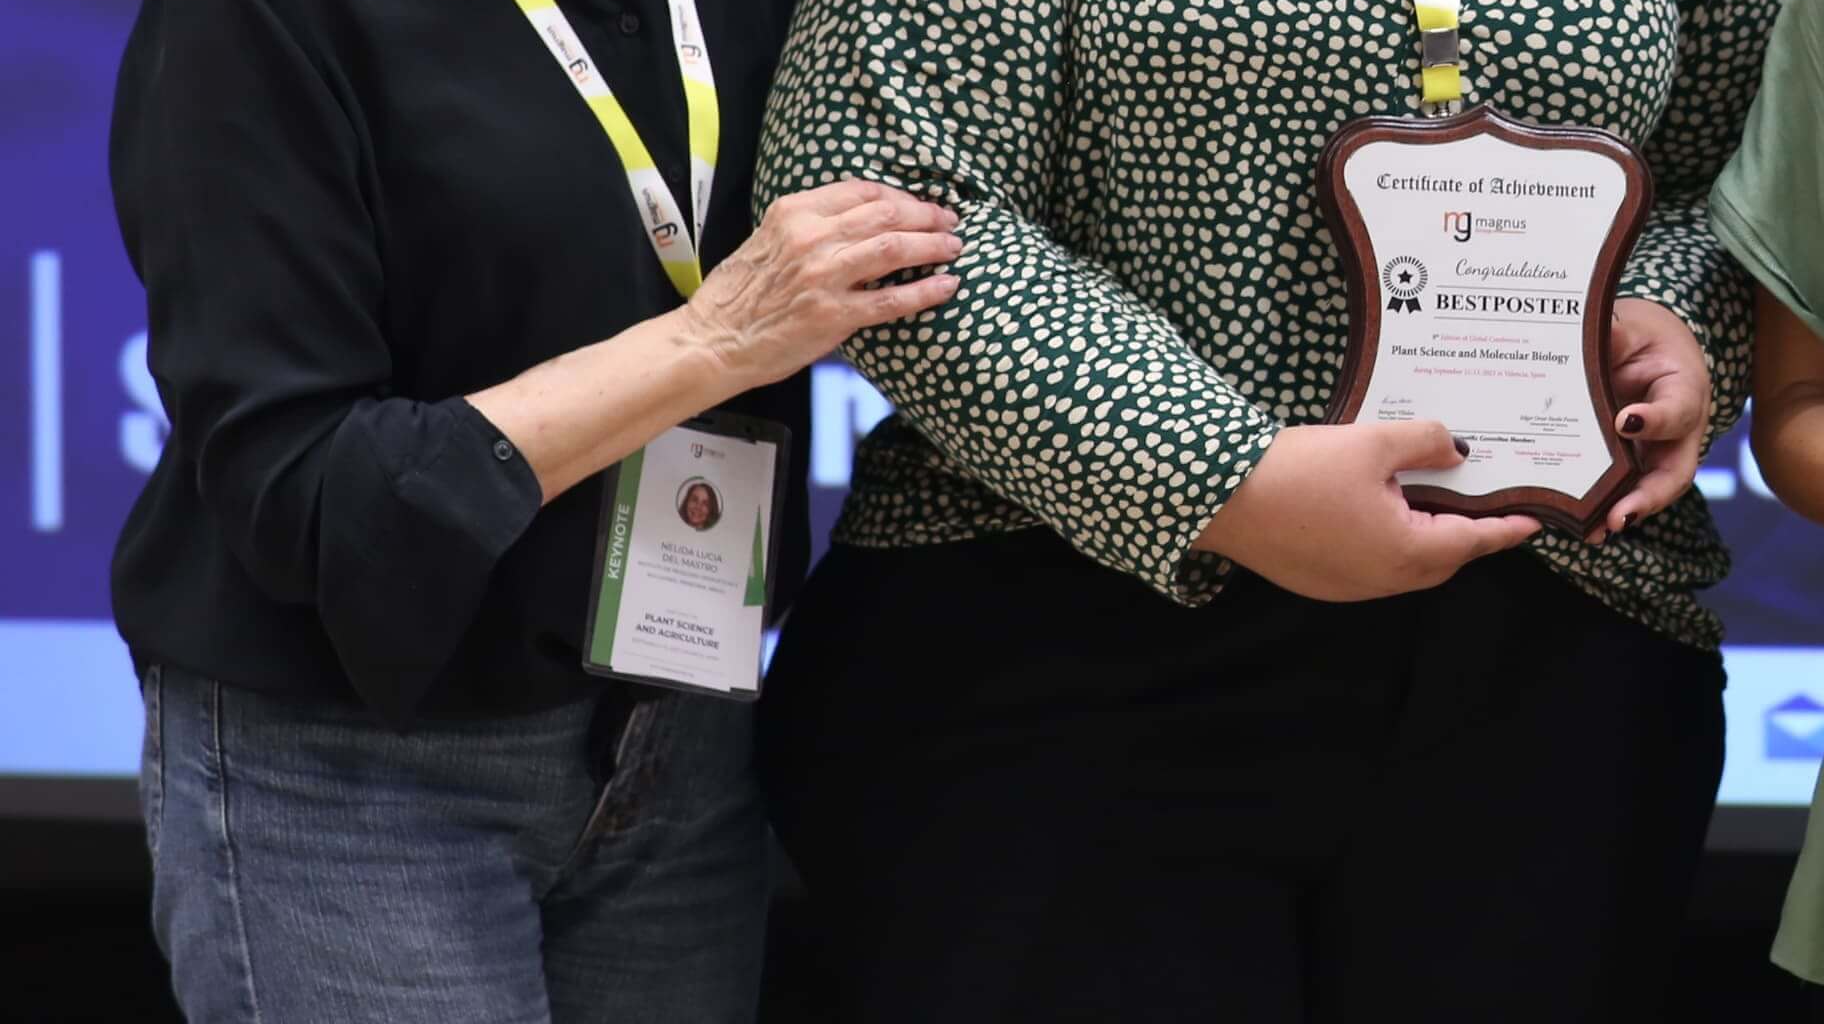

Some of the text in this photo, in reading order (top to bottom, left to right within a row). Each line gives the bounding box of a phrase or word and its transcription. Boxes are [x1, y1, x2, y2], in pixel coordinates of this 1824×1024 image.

[1376, 173, 1595, 198] Certificate of Achievement
[1475, 217, 1526, 230] magnus
[1455, 258, 1567, 280] Congratulations
[1436, 293, 1580, 316] BESTPOSTER
[1391, 346, 1570, 365] Plant Science and Molecular Biology
[607, 503, 630, 579] KEYNOTE
[662, 554, 678, 566] DEL
[645, 613, 675, 627] PLANT
[677, 621, 715, 636] SCIENCE
[635, 624, 656, 636] AND
[658, 628, 719, 650] AGRICULTURE
